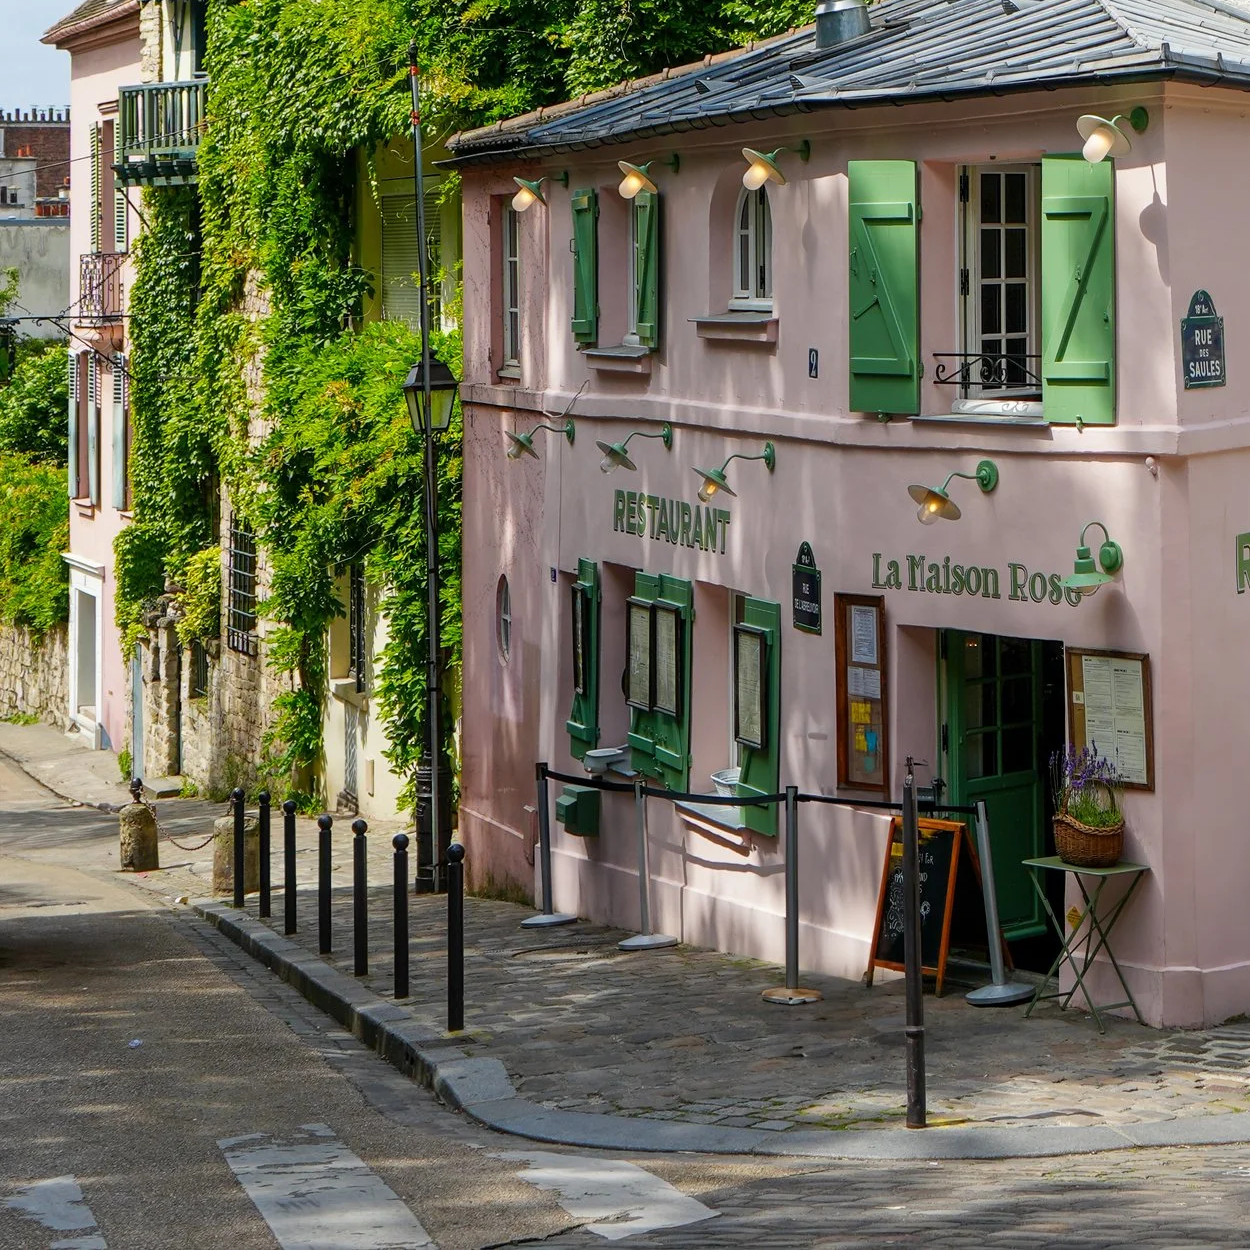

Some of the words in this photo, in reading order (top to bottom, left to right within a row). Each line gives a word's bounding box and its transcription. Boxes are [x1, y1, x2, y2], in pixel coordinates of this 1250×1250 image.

[1195, 329, 1212, 345] RUE
[1199, 349, 1209, 357] DES
[1189, 360, 1221, 378] SAULES
[614, 489, 731, 554] RESTAURANT
[872, 553, 902, 590] La
[906, 555, 1001, 599] Maison
